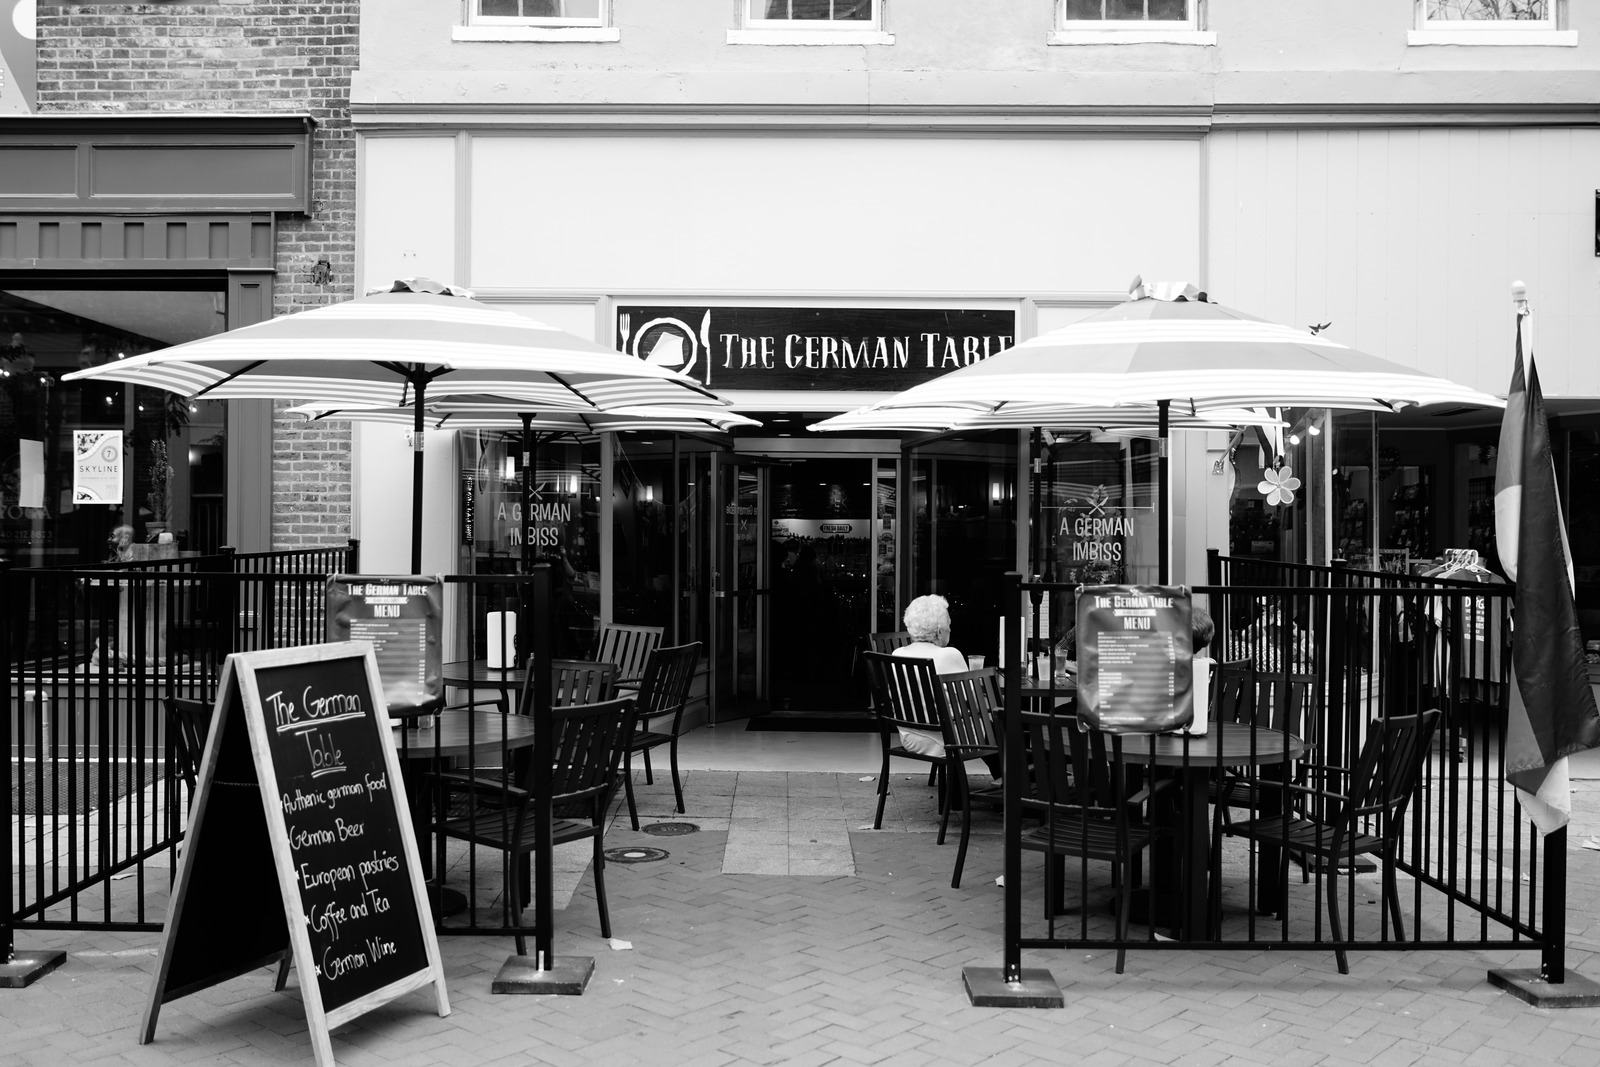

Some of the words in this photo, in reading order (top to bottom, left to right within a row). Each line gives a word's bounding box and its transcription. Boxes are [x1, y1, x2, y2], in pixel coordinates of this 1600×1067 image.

[720, 333, 775, 369] THE
[785, 333, 910, 369] GERMAN
[79, 465, 119, 473] SKYLINE
[497, 501, 507, 520] A
[512, 502, 571, 522] GRMAN
[1059, 517, 1070, 535] A
[1074, 517, 1134, 537] GERMAN
[1072, 541, 1122, 561] IMBISS
[346, 583, 364, 596] THE
[364, 583, 400, 596] GERMAN
[402, 584, 428, 596] TABLE
[1094, 595, 1112, 608] THE
[1114, 595, 1149, 608] GERMAN
[1149, 596, 1174, 609] TABLE
[373, 605, 401, 618] MENU
[1123, 617, 1151, 630] MENU
[265, 690, 300, 726] The
[302, 685, 361, 718] German
[294, 727, 345, 769] Table
[327, 783, 364, 810] german
[364, 772, 387, 802] food
[290, 825, 335, 851] German
[335, 817, 365, 842] Beer
[301, 862, 356, 892] European
[358, 850, 399, 891] pastries
[310, 901, 347, 942] Coffee
[350, 892, 369, 919] and
[366, 888, 391, 914] Tea
[322, 946, 369, 981] German
[366, 935, 398, 963] Wine
